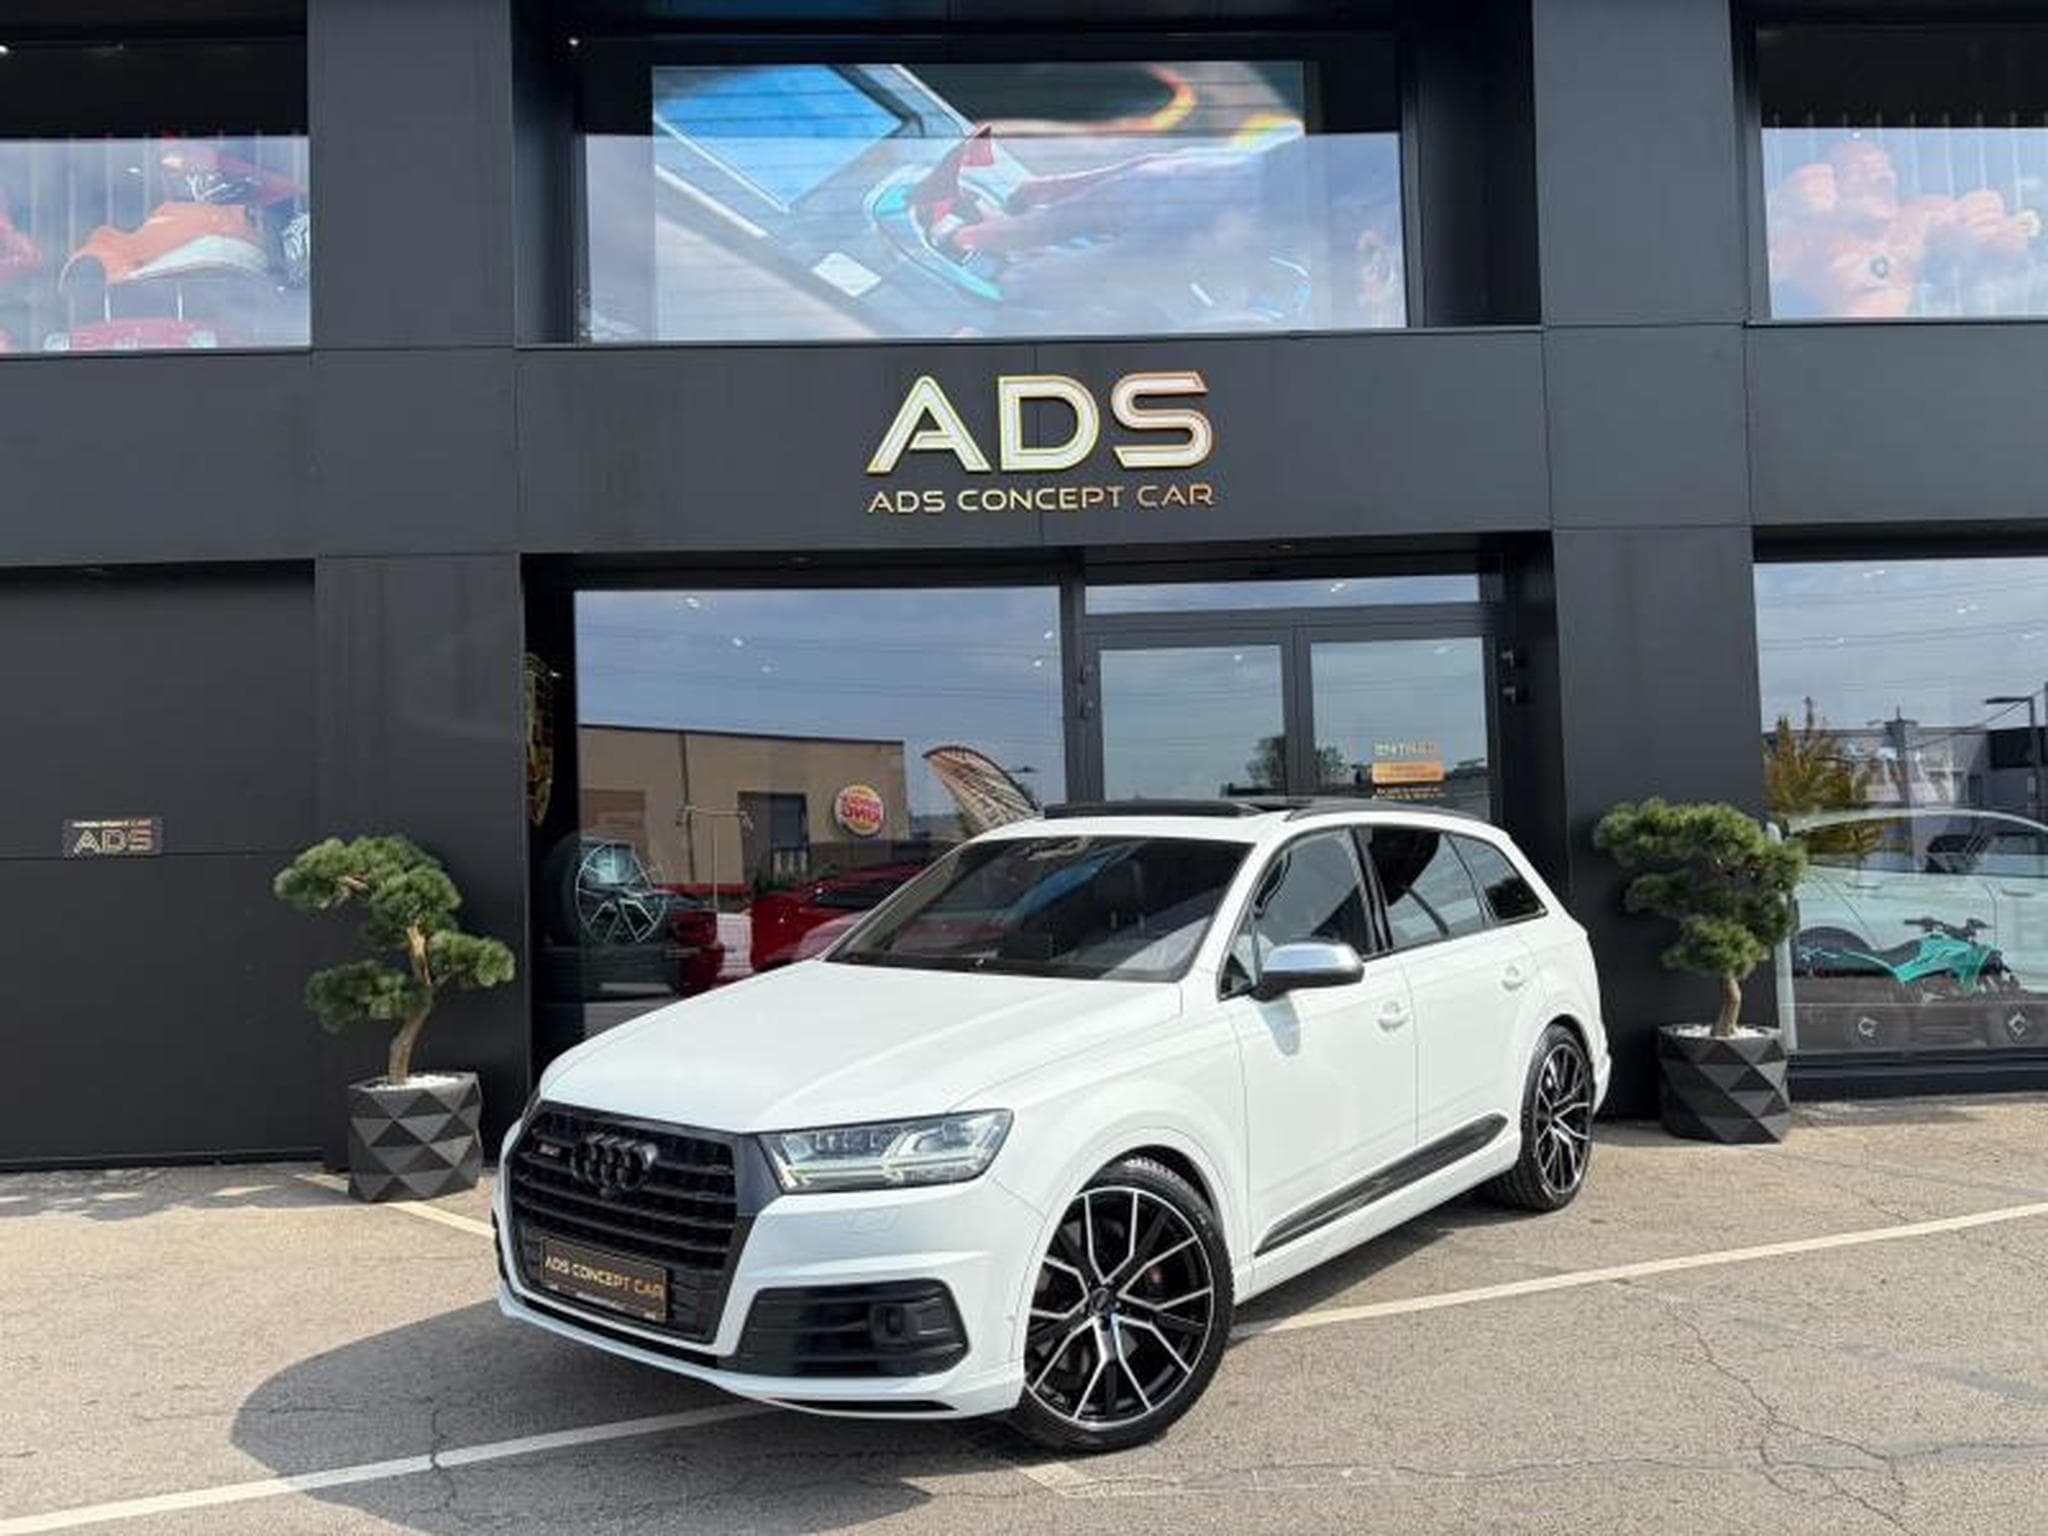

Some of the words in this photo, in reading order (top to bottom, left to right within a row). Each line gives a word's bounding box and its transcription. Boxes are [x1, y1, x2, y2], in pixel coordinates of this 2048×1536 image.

[866, 371, 1214, 474] ADS
[868, 490, 946, 513] ADS
[956, 486, 1124, 512] CONCEPT
[1136, 483, 1214, 507] CAR
[73, 829, 153, 855] ADS
[544, 1256, 570, 1275] ADS
[572, 1263, 630, 1291] CONCEPT
